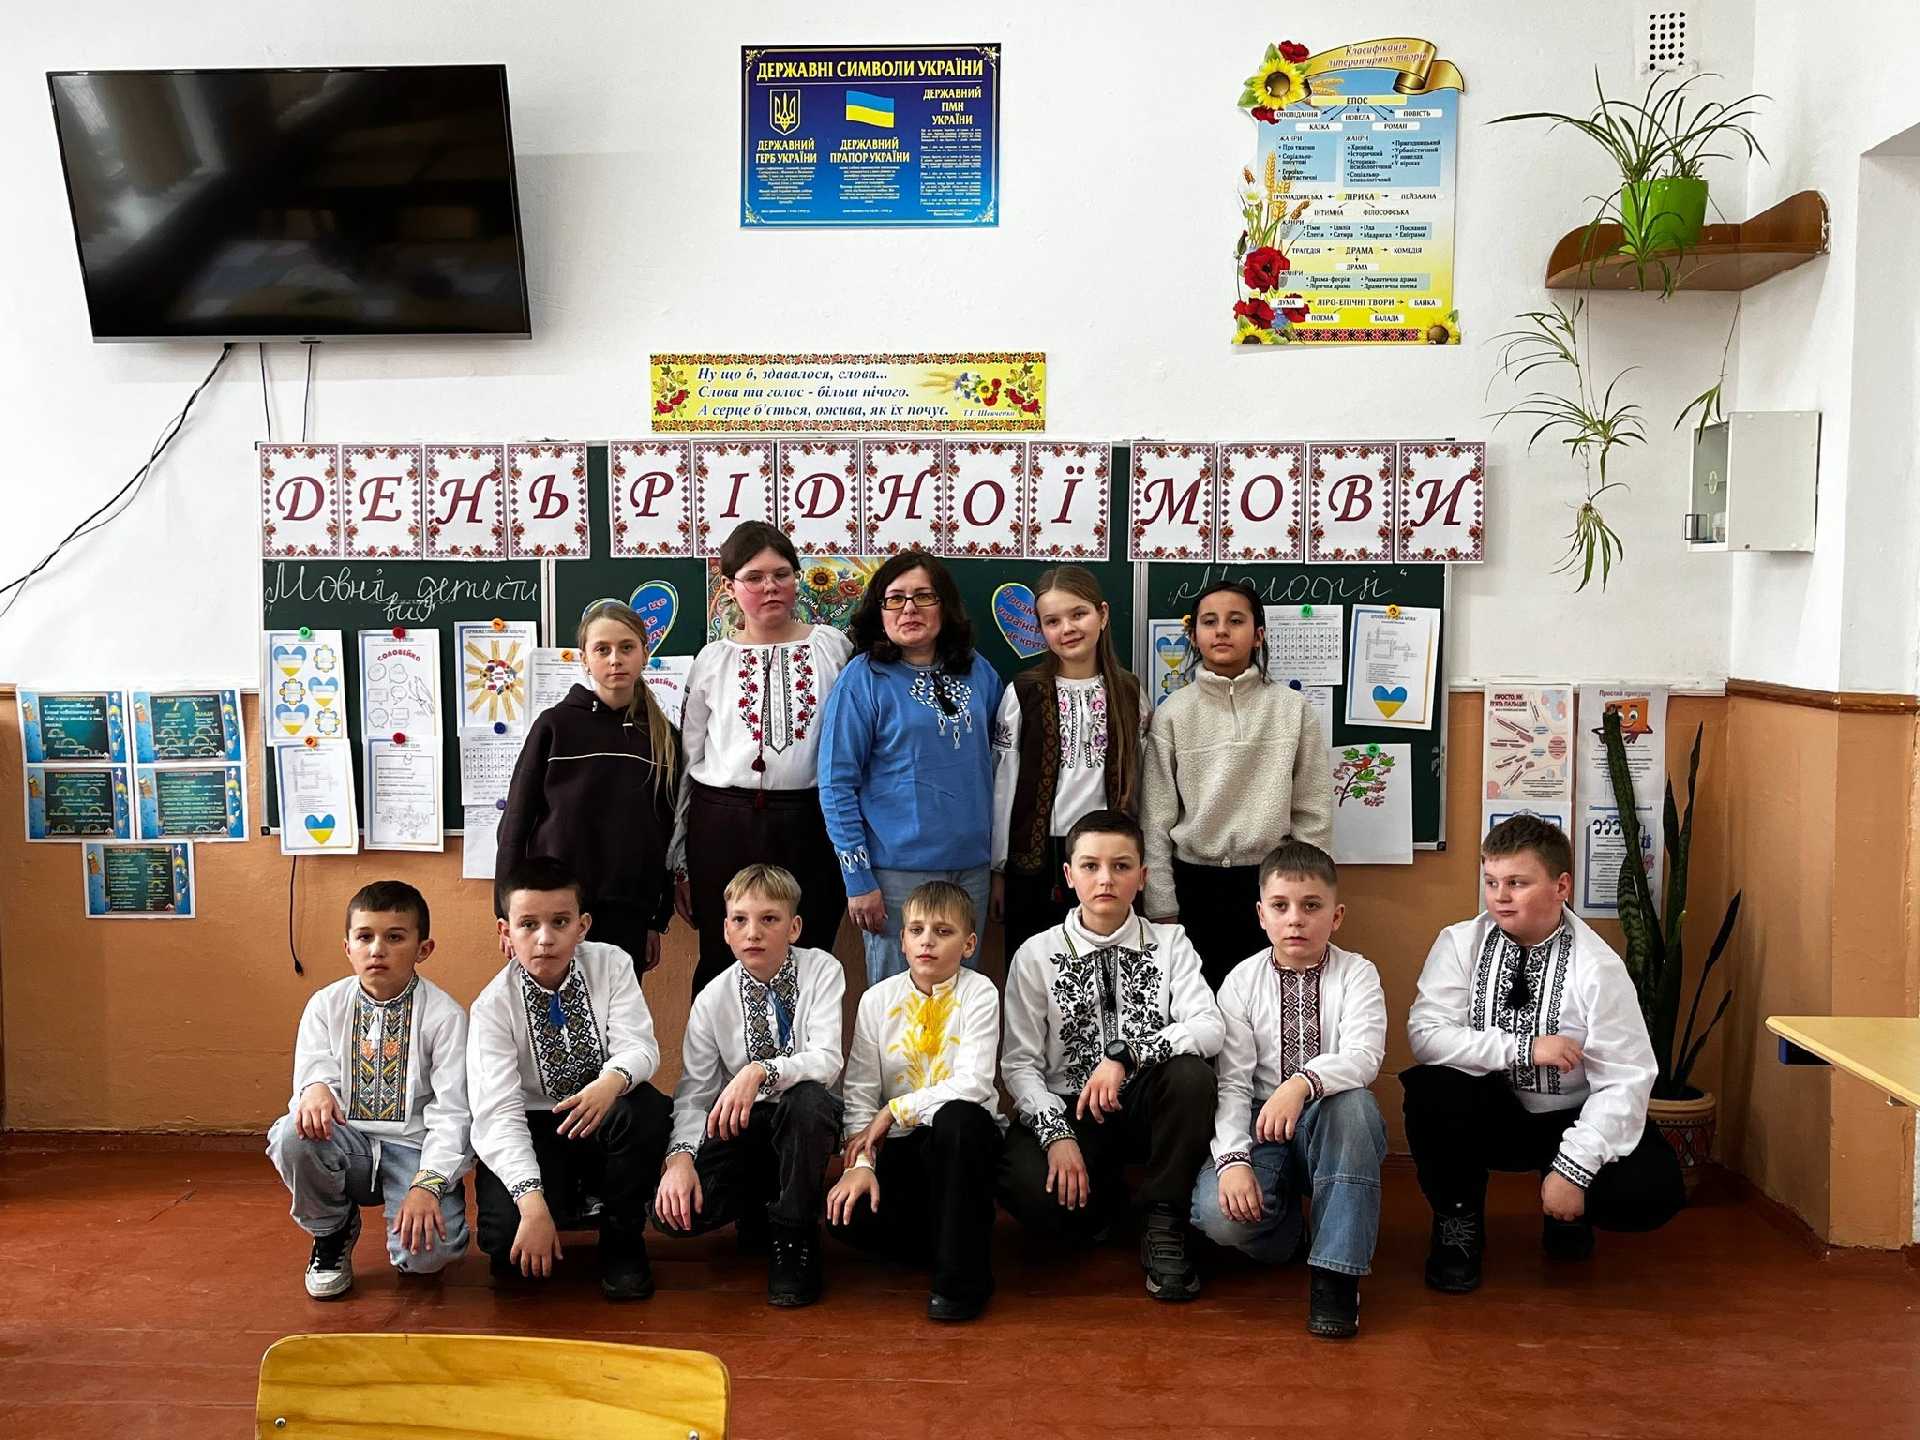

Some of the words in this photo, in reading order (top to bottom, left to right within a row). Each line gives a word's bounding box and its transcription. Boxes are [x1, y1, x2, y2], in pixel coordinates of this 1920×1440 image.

[757, 62, 833, 81] ДЕРЖАВНІ
[837, 60, 914, 77] СИМВОЛИ
[917, 58, 984, 76] УКРАЇНИ
[923, 86, 982, 100] ДЕРЖАВНИЙ
[931, 112, 973, 125] УКРАЇНИ
[757, 137, 815, 152] ДЕРЖАВНИЙ
[839, 137, 899, 151] ДЕРЖАВНИЙ
[755, 152, 777, 164] ГЕРБ
[777, 150, 817, 164] УКРАЇНИ
[830, 151, 869, 164] ПРАПОР
[869, 149, 910, 163] УКРАЇНИ
[698, 367, 718, 382] Ну
[720, 369, 742, 382] що
[762, 368, 833, 381] здавалося,
[698, 386, 739, 398] Слова
[742, 387, 763, 398] та
[766, 387, 804, 398] голос
[862, 385, 909, 398] нічого.
[698, 404, 708, 416] А
[712, 405, 751, 419] серце
[870, 404, 887, 416] як
[890, 403, 903, 416] їх
[275, 474, 569, 525] ДЕНЬ
[630, 465, 1085, 526] РІДНОЇ
[1134, 473, 1477, 527] МОВИ
